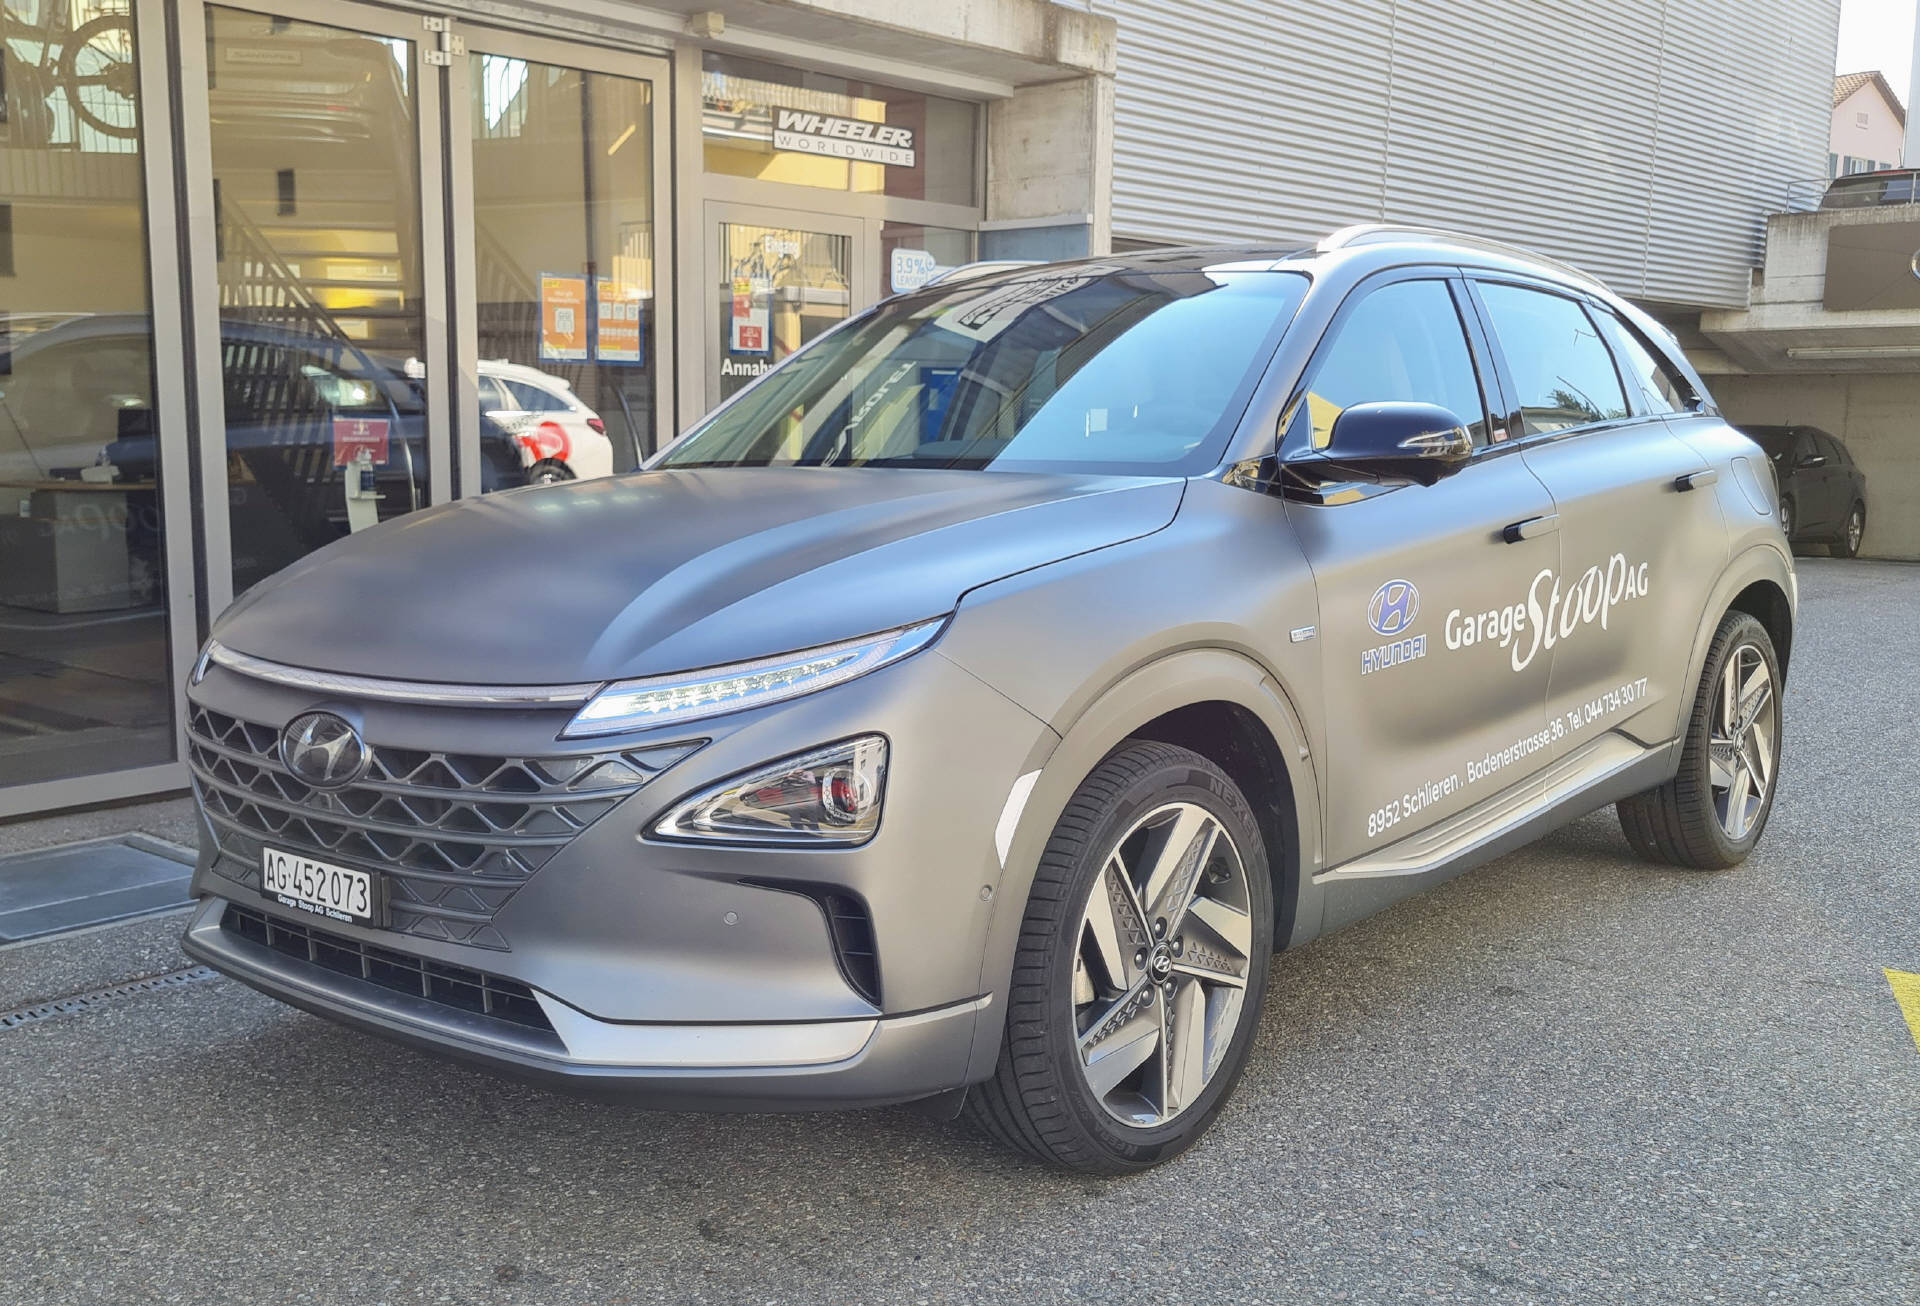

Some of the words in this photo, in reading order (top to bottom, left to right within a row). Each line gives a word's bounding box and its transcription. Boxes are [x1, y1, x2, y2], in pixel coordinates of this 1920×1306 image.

[778, 110, 912, 148] WHEELER
[778, 135, 912, 164] WORLDWIDE
[721, 358, 772, 376] Annah
[1445, 603, 1526, 650] Garage
[1511, 553, 1626, 672] Stoop
[1625, 562, 1649, 600] AG
[1361, 634, 1427, 675] HYUNDAI
[1367, 800, 1400, 838] 8952
[1466, 729, 1551, 783] Badenerstrasse
[1549, 718, 1564, 741] 36
[1567, 708, 1585, 733] Tel.
[1584, 698, 1603, 723] 044
[1603, 689, 1621, 714] 734
[1621, 684, 1634, 705] 30
[1635, 677, 1648, 699] 77
